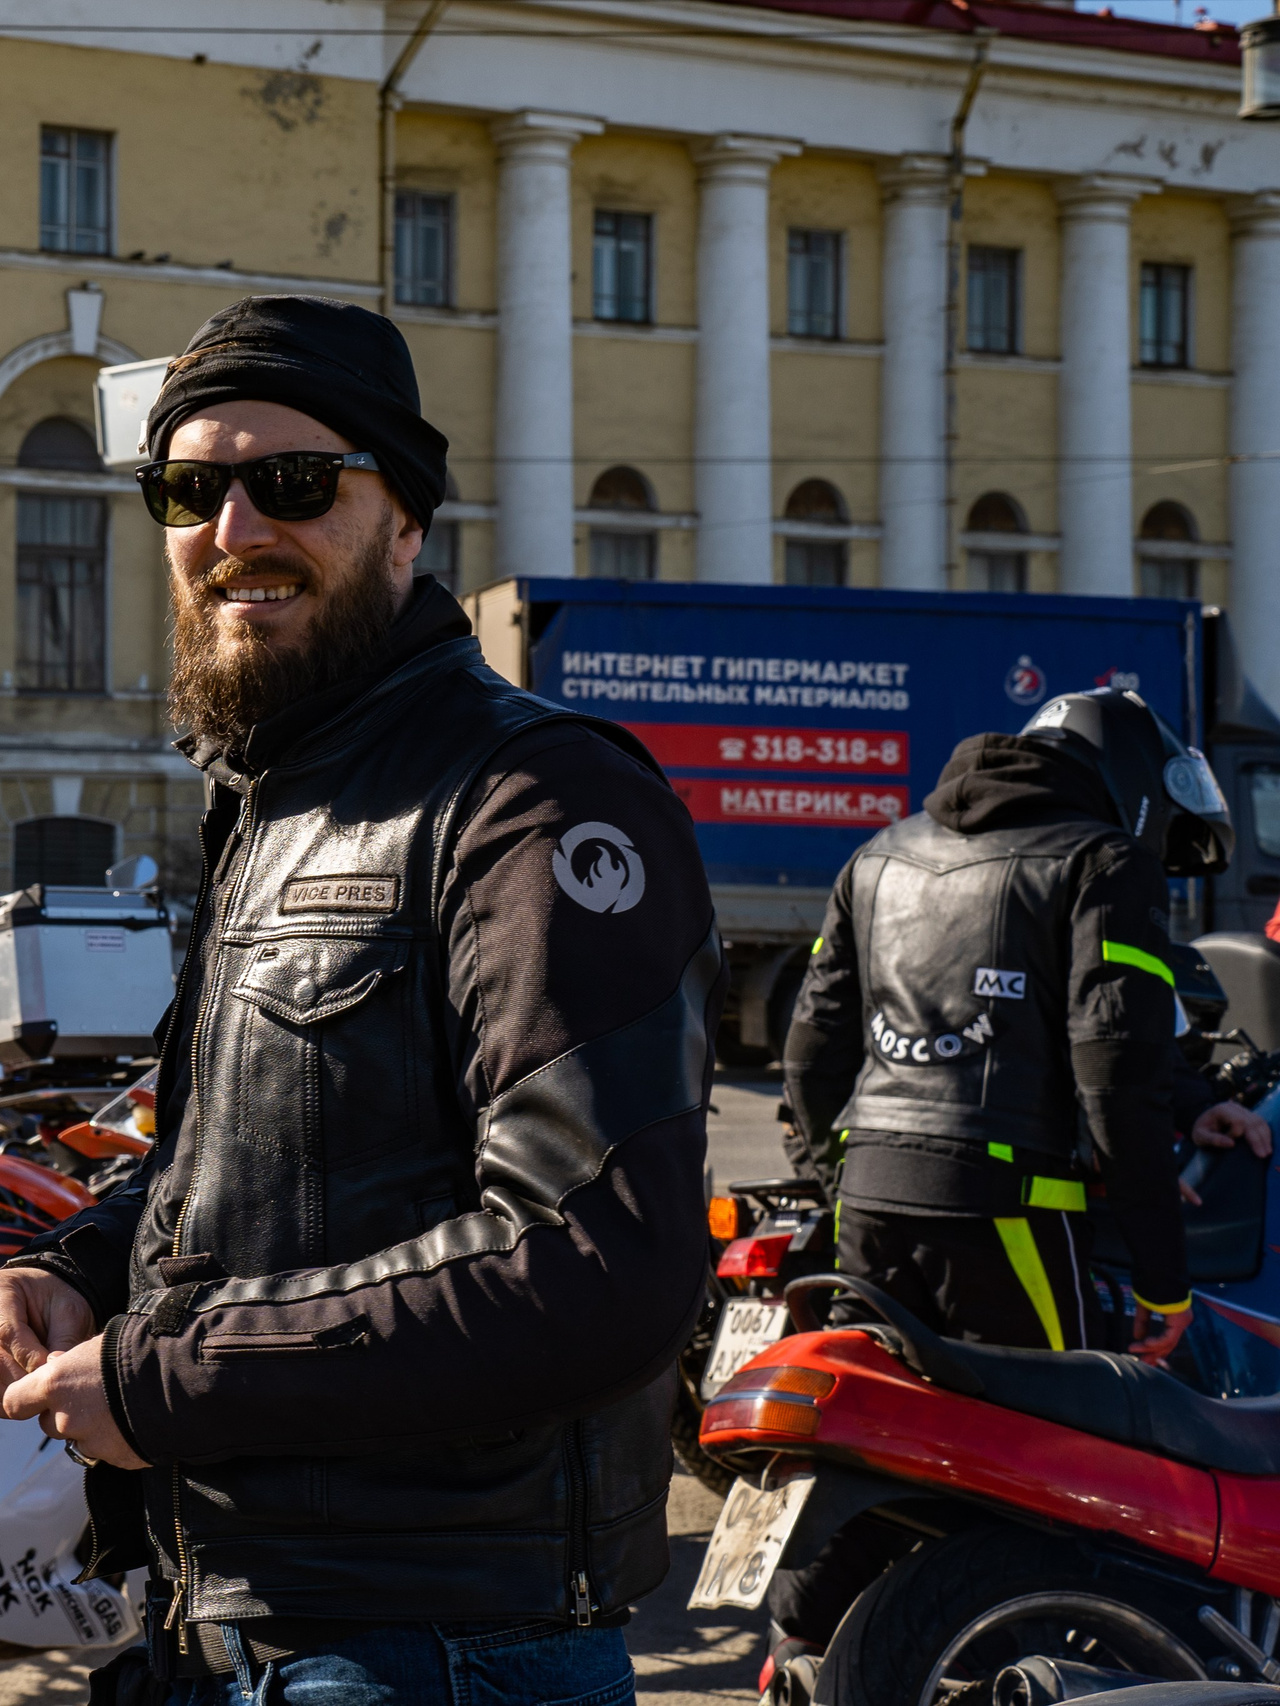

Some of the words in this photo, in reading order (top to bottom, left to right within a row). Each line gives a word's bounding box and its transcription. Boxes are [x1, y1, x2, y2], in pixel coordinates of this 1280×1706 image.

[562, 651, 705, 679] ИНТЕРНЕТ
[711, 656, 909, 686] ГИПЕРМАРКЕТ
[562, 678, 749, 705] СТРОИТЕЛЬНЫХ
[754, 686, 910, 710] МАТЕРИАЛОВ
[752, 735, 900, 765] 318-318-8
[721, 788, 902, 818] МАТЕРИК.РФ
[292, 885, 328, 902] VICE
[334, 884, 386, 902] PRES
[978, 973, 1024, 995] MC
[870, 1012, 994, 1062] MOSCOW
[730, 1307, 777, 1334] 0067
[16, 1552, 55, 1613] NGK
[57, 1583, 94, 1639] MICHELIN
[94, 1597, 123, 1638] GAS
